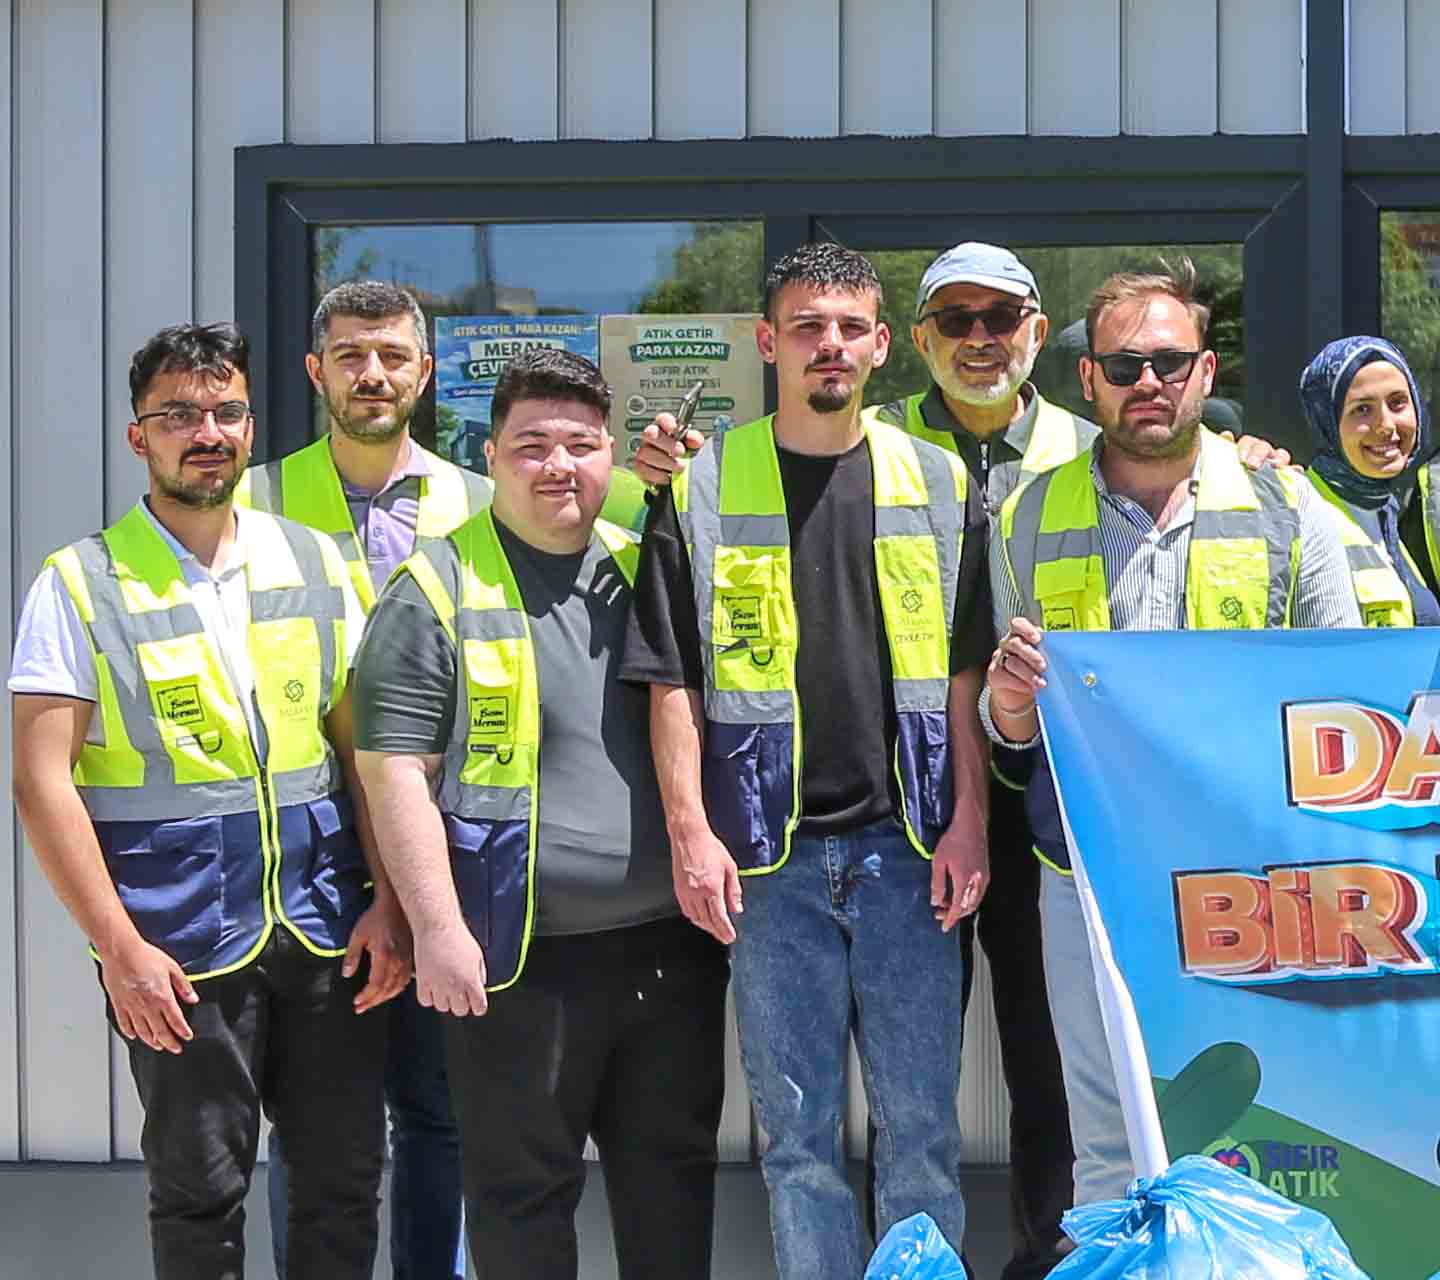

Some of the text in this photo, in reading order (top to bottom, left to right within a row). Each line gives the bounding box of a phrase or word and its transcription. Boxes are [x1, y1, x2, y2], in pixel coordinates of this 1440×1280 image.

[644, 326, 713, 339] ATIK GETİR
[636, 345, 671, 357] PARA
[1172, 866, 1426, 976] BİR
[1263, 1142, 1341, 1170] SIFIR
[1268, 1170, 1342, 1198] ATIK
